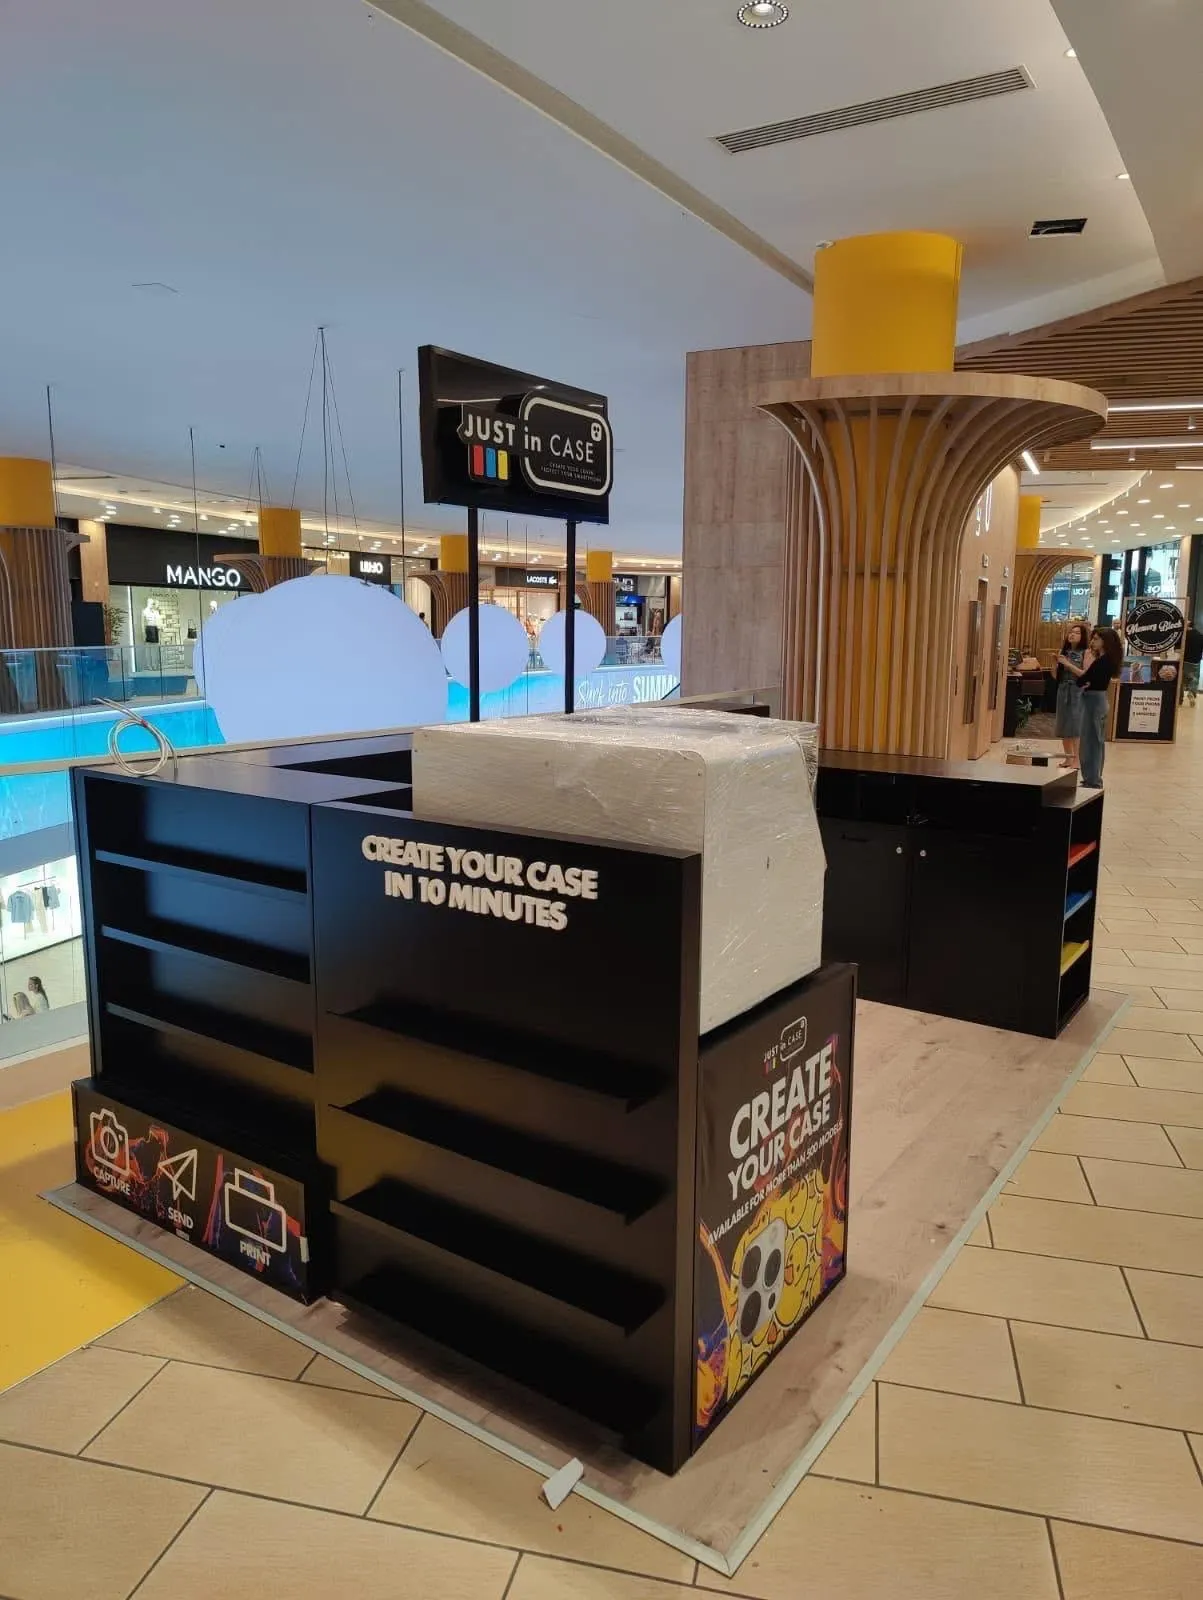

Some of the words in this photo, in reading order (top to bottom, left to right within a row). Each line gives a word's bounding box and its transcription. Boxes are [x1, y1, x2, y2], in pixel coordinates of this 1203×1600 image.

[464, 413, 516, 446] JUST
[524, 426, 541, 452] in
[550, 434, 594, 463] CASE
[166, 564, 241, 588] MANGO
[526, 575, 548, 584] LACOSTE
[608, 680, 629, 704] into
[633, 674, 680, 704] SUMM
[362, 835, 445, 872] CREATE
[446, 847, 524, 887] YOUR
[527, 862, 598, 900] CASE
[384, 870, 413, 899] IN
[418, 876, 446, 906] 10
[448, 882, 568, 931] MINUTES
[788, 1029, 802, 1046] CASE
[729, 1042, 832, 1160] CREATE
[727, 1131, 785, 1200] YOUR
[789, 1093, 831, 1149] CASE
[93, 1166, 131, 1196] CAPTURE
[708, 1203, 750, 1246] AVAILABLE
[750, 1189, 765, 1210] FOR
[766, 1169, 786, 1194] MORE
[787, 1152, 806, 1177] THAN
[818, 1120, 843, 1149] MODELS
[168, 1206, 194, 1229] SEND
[240, 1240, 271, 1267] PRINT
